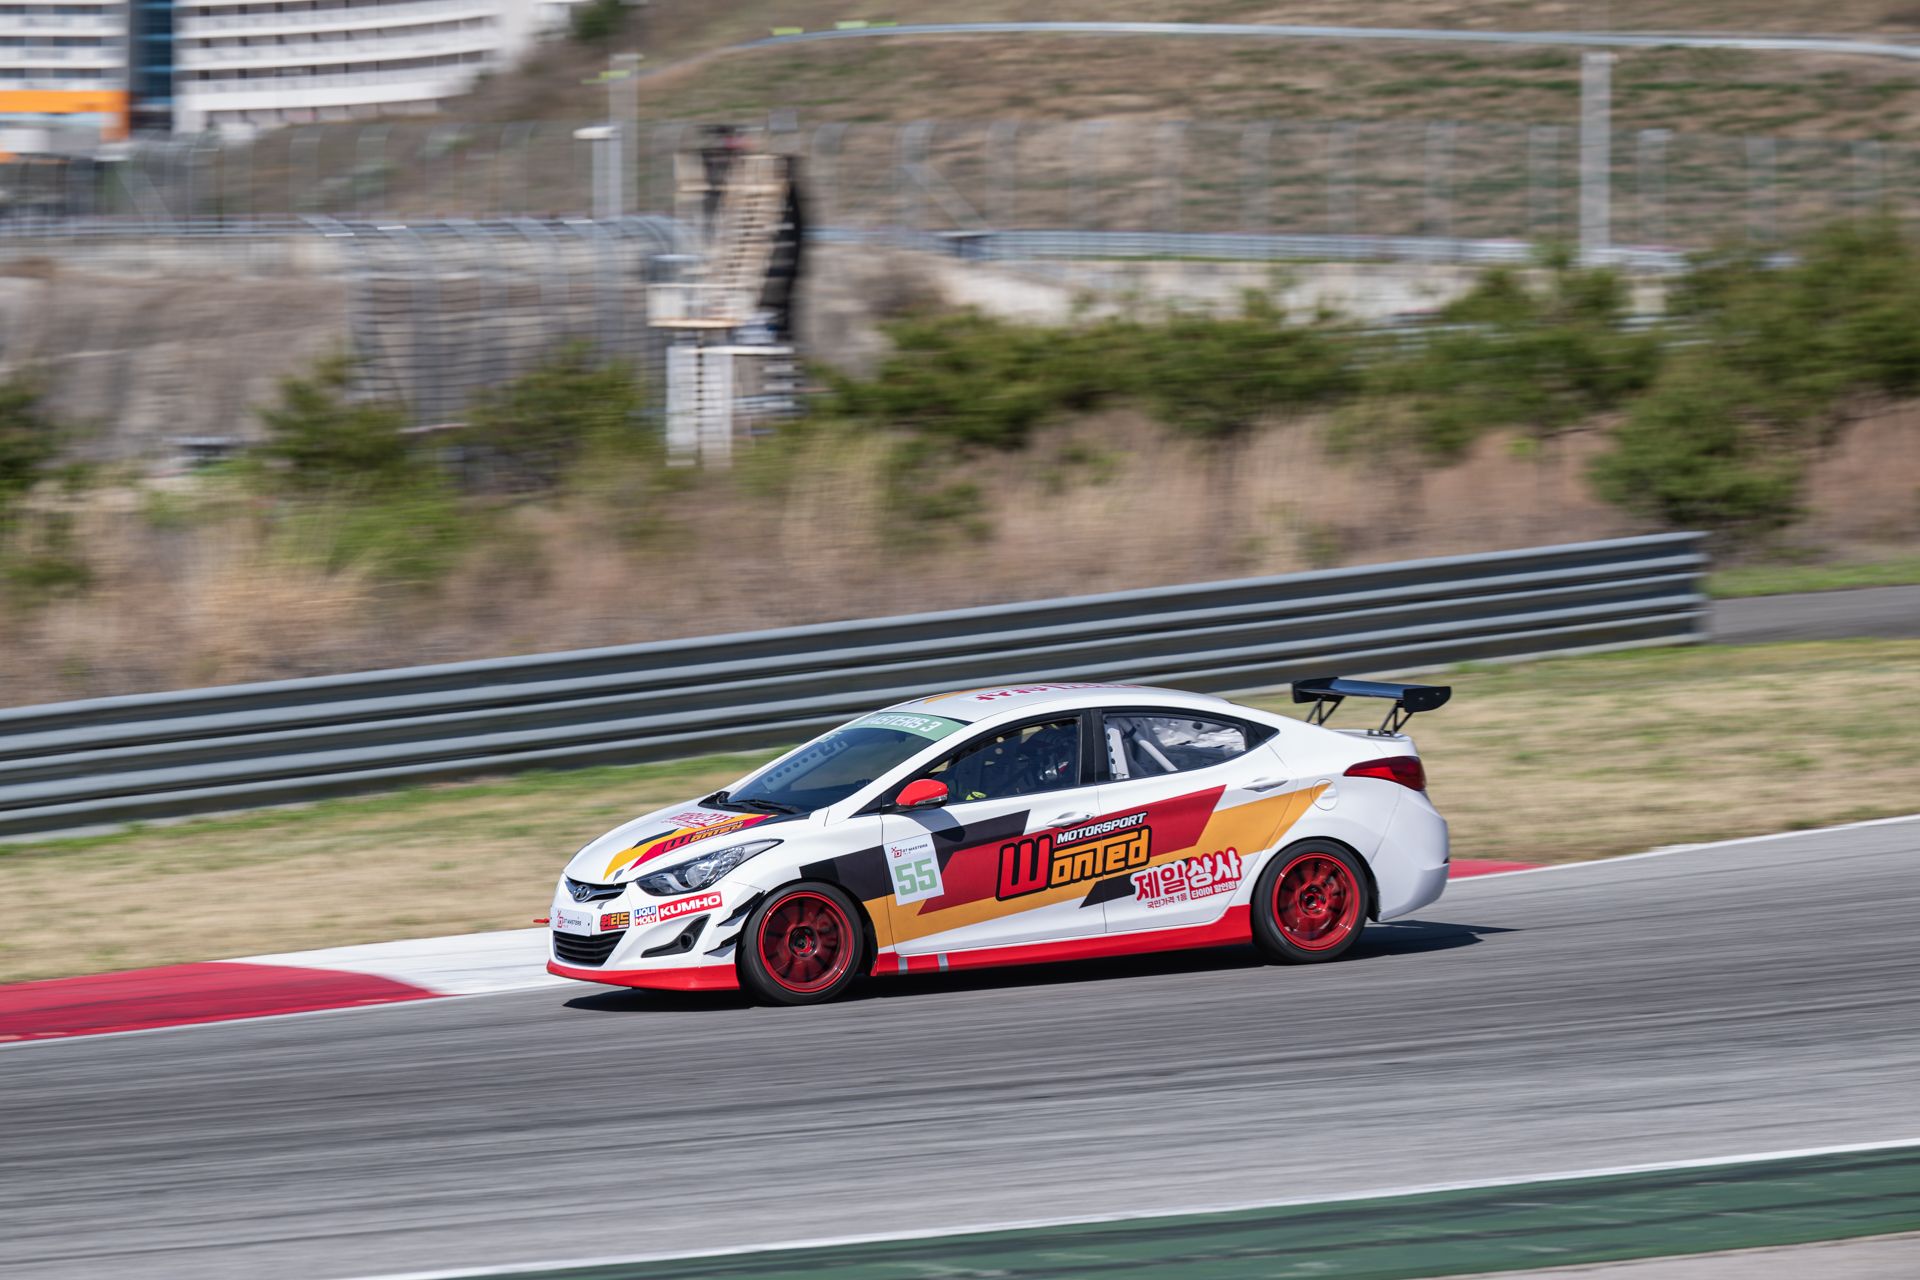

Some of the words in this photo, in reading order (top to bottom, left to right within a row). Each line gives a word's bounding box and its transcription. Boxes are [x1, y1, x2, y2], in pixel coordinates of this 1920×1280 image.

[919, 720, 943, 732] 3
[1057, 812, 1148, 845] MOTORSPORT
[895, 858, 938, 896] 55
[1133, 848, 1241, 901] 제일상사
[1191, 886, 1213, 899] 타이어
[635, 906, 656, 917] LIQUI
[660, 895, 721, 918] KUMHO
[635, 915, 656, 926] MOLY
